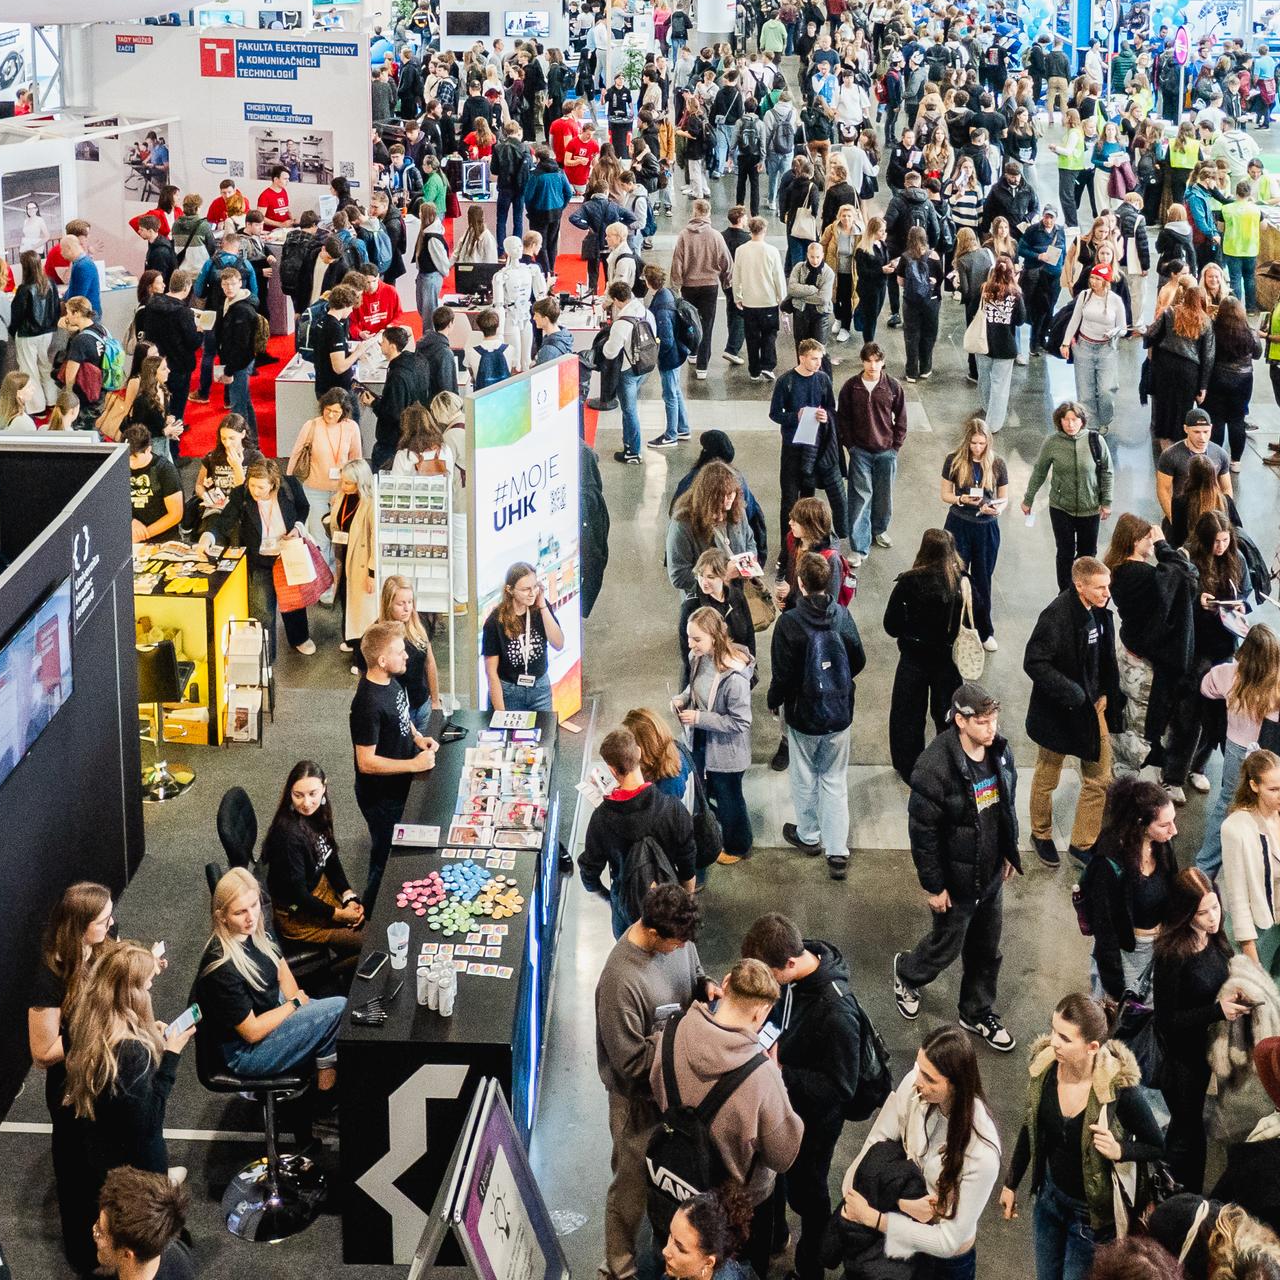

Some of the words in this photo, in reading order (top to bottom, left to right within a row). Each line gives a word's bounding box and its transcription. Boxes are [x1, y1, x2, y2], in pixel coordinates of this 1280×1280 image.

[238, 42, 274, 53] FAKULTA
[275, 43, 355, 55] ELEKTROTECHNIKY
[246, 56, 317, 67] KOMUNIKAČNÍCH
[239, 68, 295, 79] TECHNOLOGIÍ
[494, 453, 559, 505] #MOJE
[494, 491, 536, 531] UHK
[646, 1157, 703, 1202] VAN
